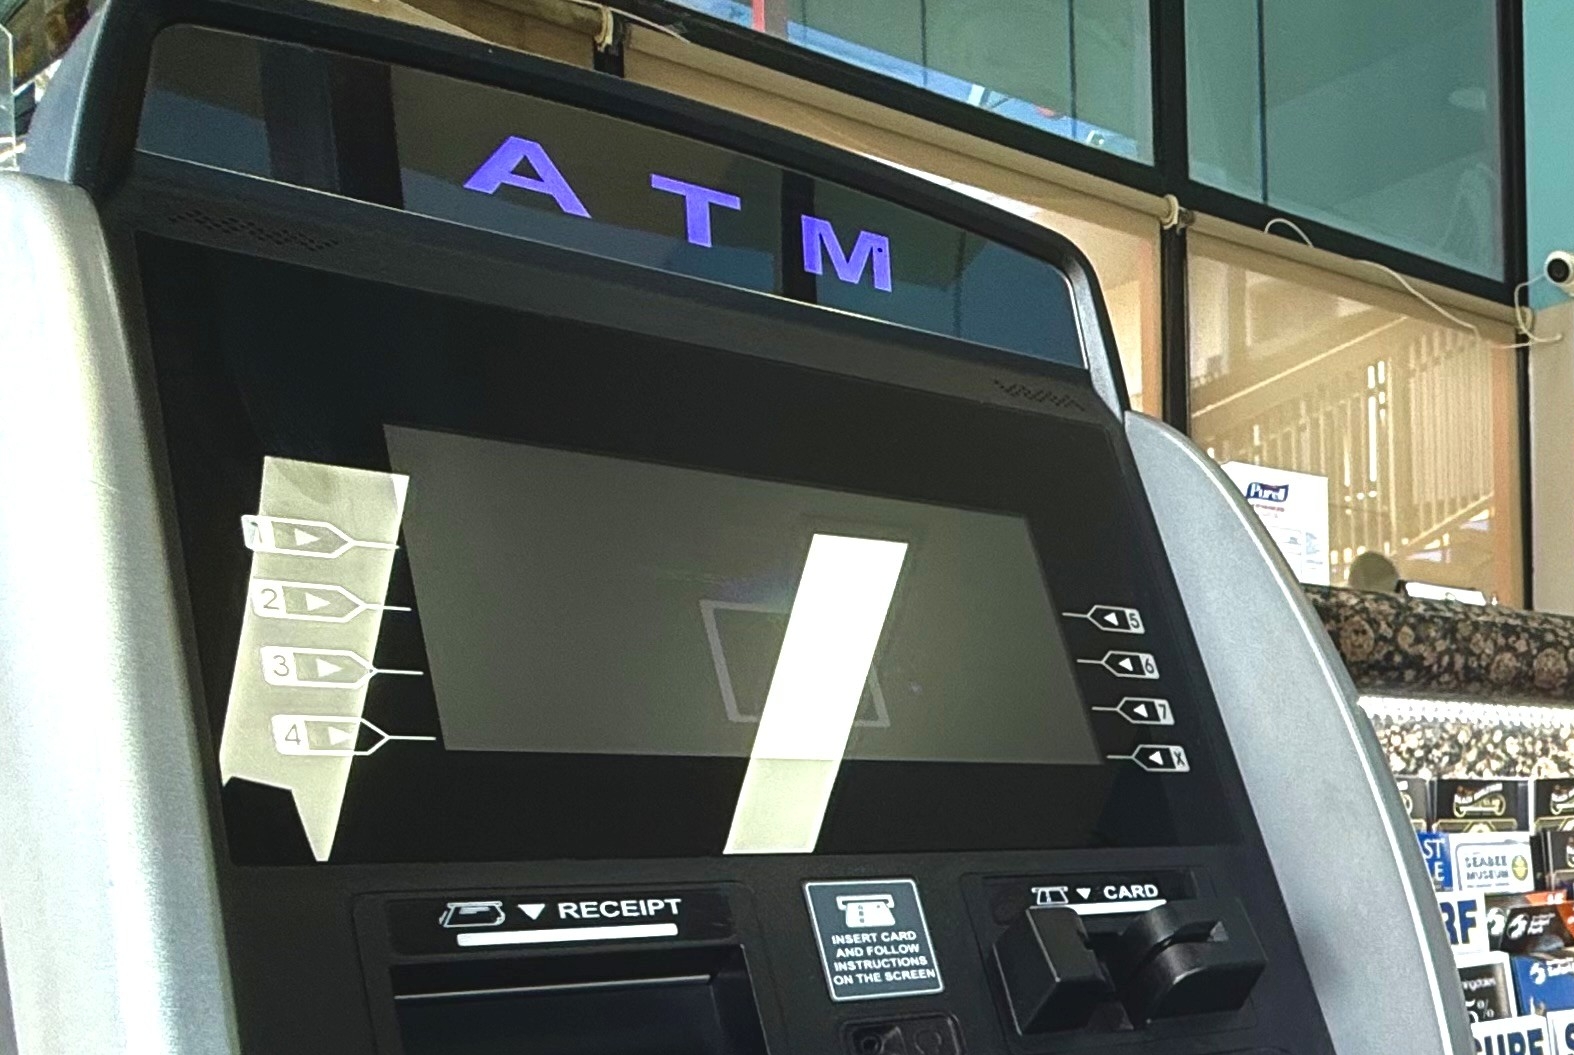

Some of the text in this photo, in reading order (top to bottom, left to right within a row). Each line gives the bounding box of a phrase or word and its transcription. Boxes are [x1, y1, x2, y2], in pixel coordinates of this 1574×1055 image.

[462, 135, 892, 292] ATM
[260, 588, 280, 610] 2
[1128, 612, 1140, 629] 5
[272, 654, 290, 677] 3
[1144, 657, 1155, 674] 6
[1158, 703, 1167, 720] 7
[284, 724, 301, 746] 4
[1103, 883, 1159, 900] CARD
[557, 898, 682, 920] RECEIPT
[832, 930, 917, 945] INSERT CARD
[836, 944, 920, 958] AND FOLLOW
[834, 956, 928, 972] INSTRUCTIONS
[833, 968, 936, 985] ON THE SCREEN
